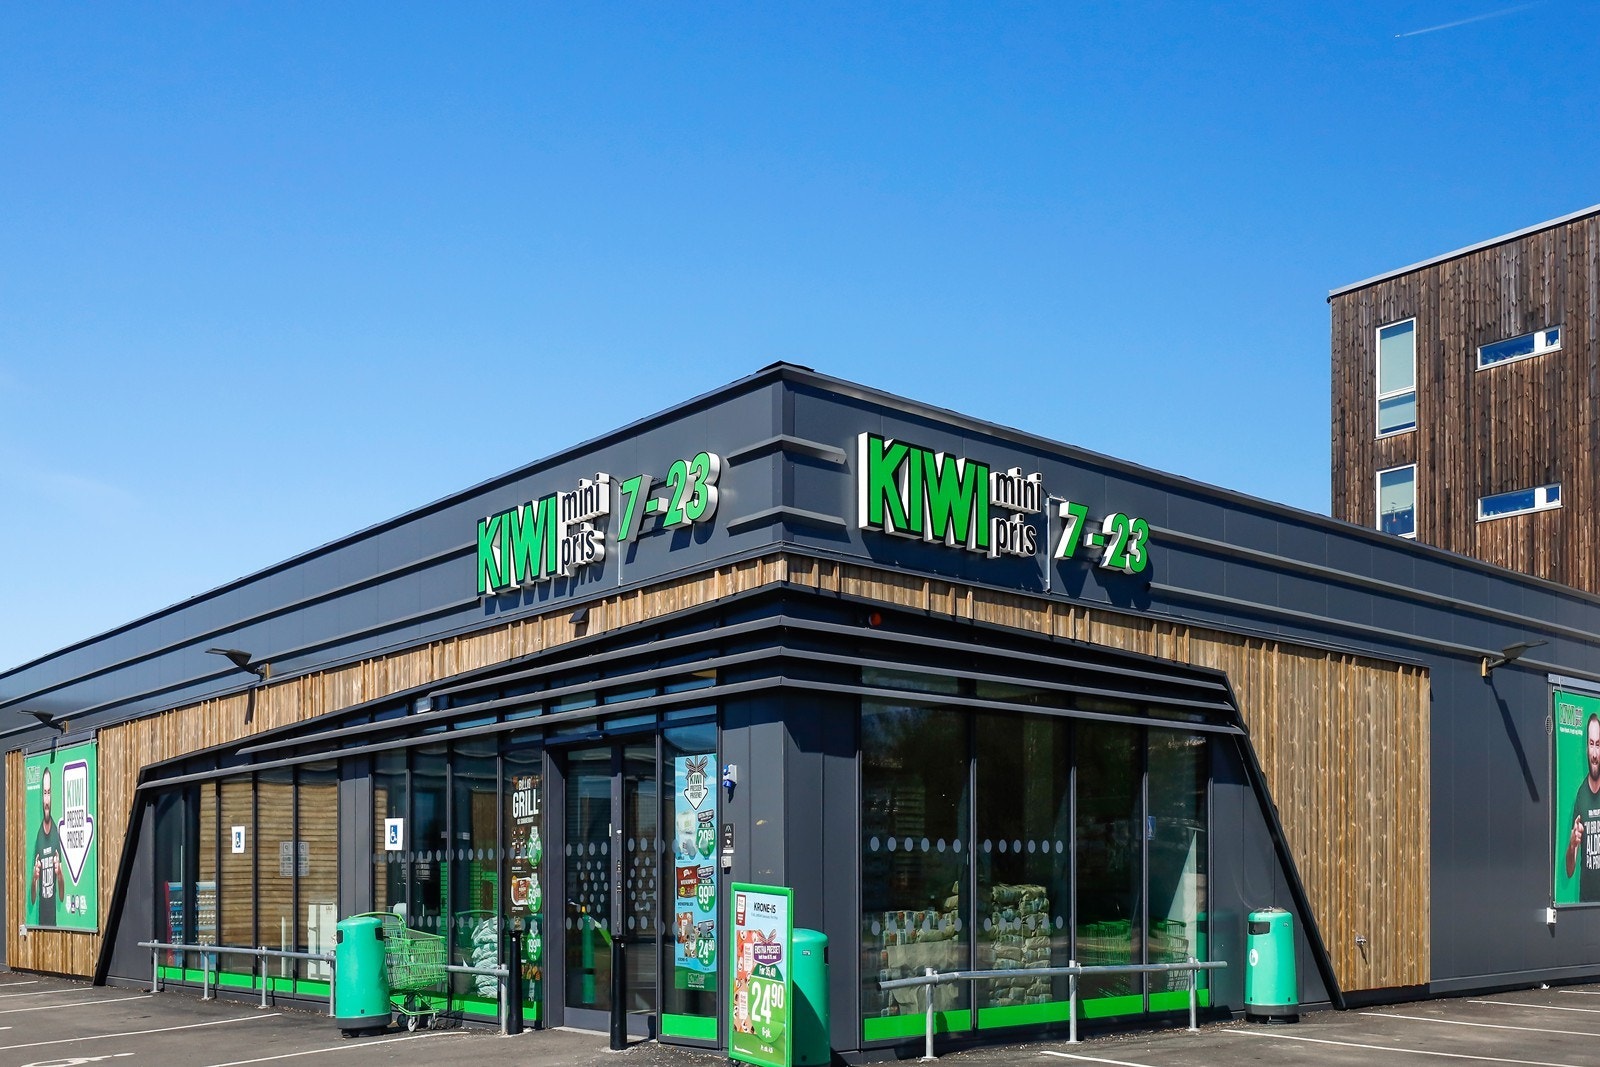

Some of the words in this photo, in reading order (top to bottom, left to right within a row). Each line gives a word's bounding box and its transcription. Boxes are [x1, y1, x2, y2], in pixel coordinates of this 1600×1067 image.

[561, 472, 607, 524] mini
[861, 432, 990, 553] KIWI
[994, 467, 1042, 513] mini
[477, 491, 560, 596] KIWI
[561, 522, 603, 576] pris
[993, 514, 1038, 559] pris
[66, 778, 84, 808] KIWI
[753, 901, 777, 914] KRONE-IS
